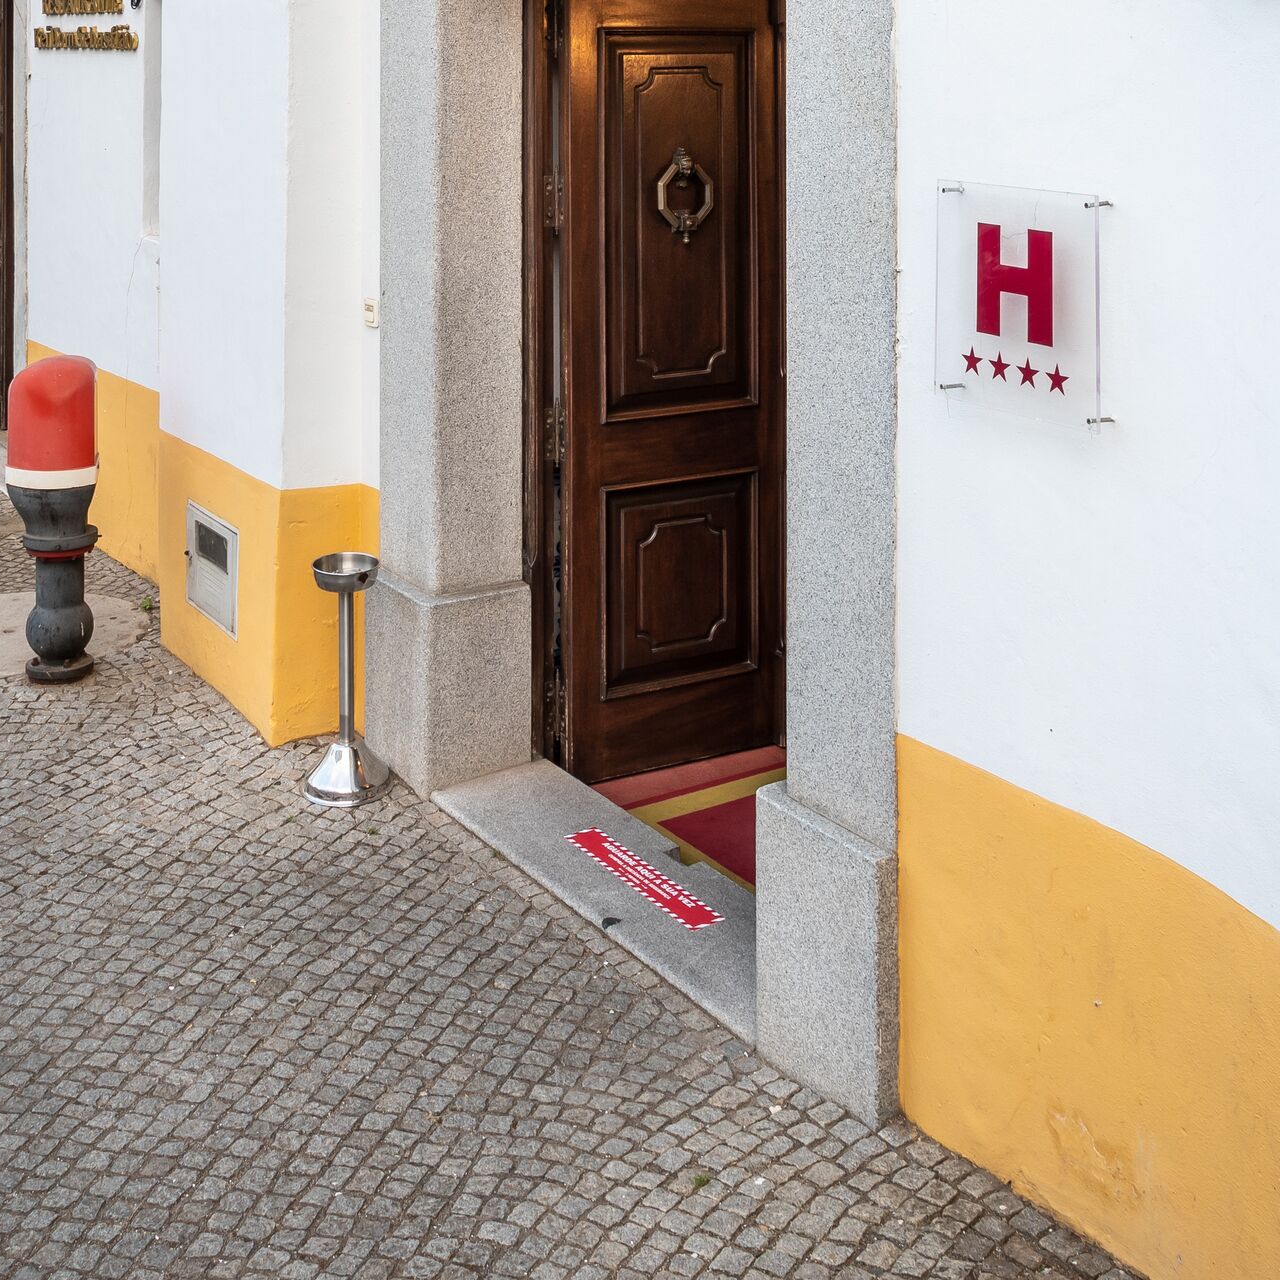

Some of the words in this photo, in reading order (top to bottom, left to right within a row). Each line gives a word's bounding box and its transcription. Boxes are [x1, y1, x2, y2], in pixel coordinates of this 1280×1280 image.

[976, 222, 1053, 347] H
[602, 842, 637, 866] AGUARDE
[635, 866, 656, 880] AQUI
[660, 884, 678, 896] SUA
[678, 895, 696, 908] VEZ
